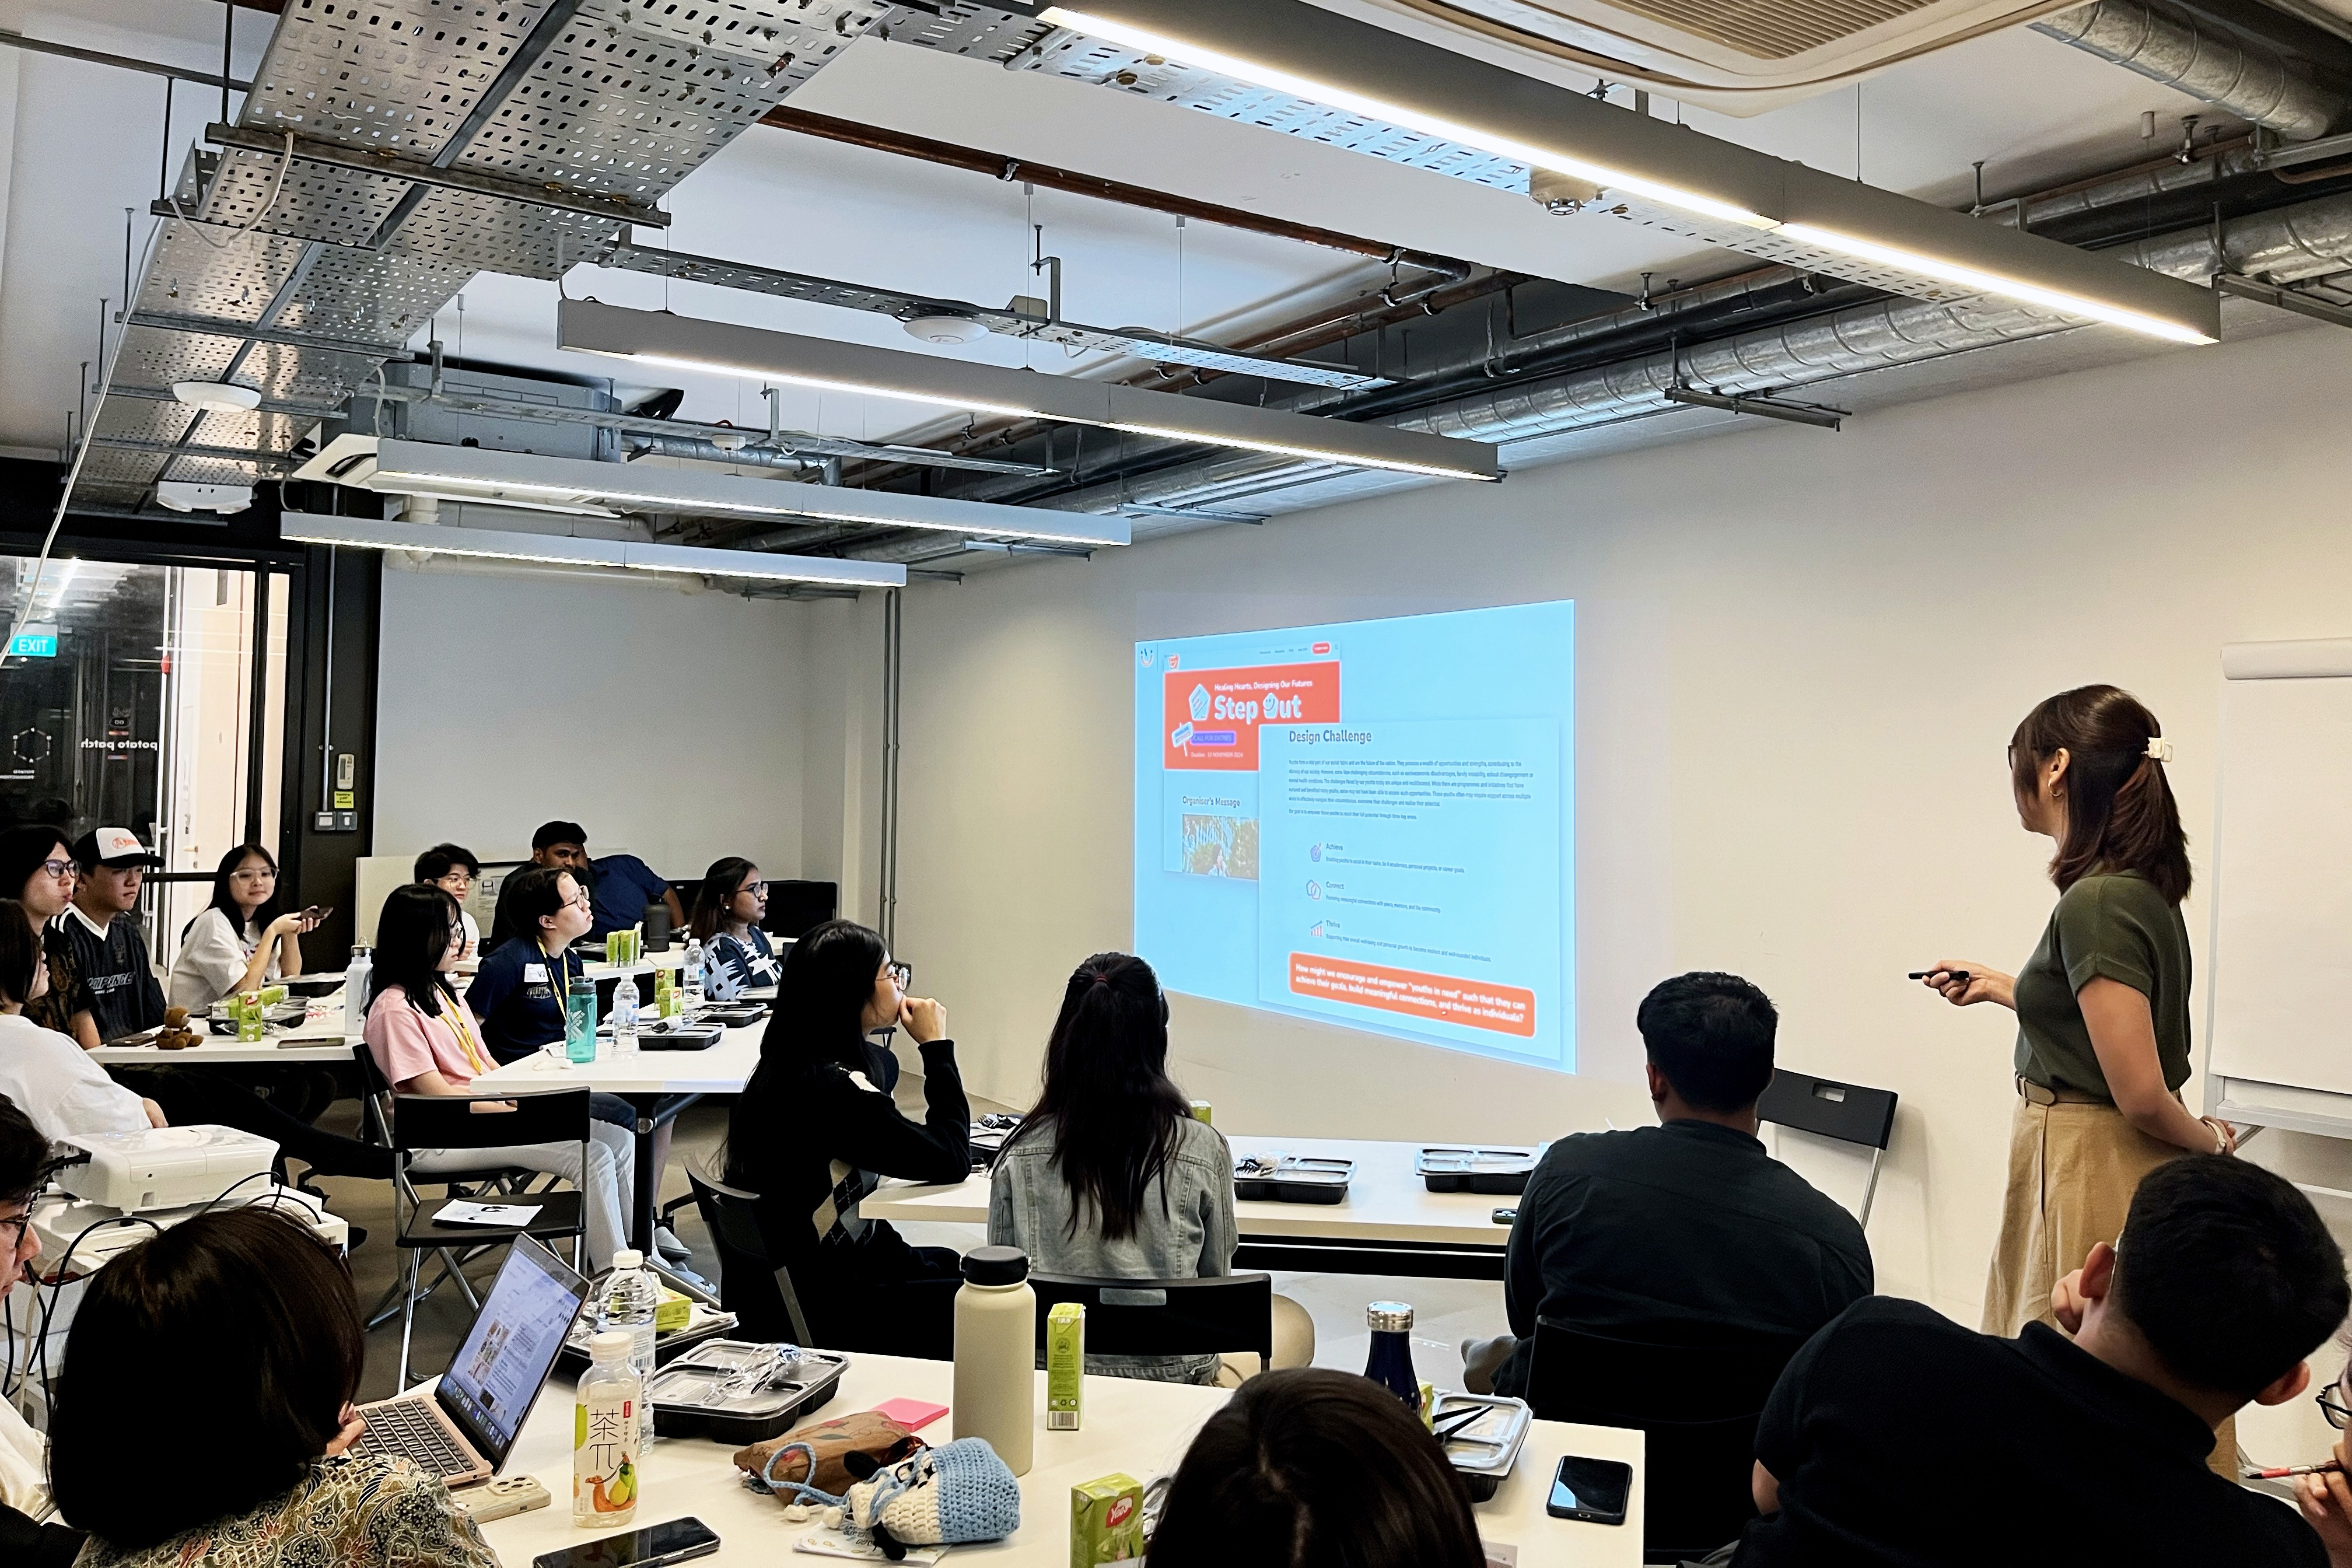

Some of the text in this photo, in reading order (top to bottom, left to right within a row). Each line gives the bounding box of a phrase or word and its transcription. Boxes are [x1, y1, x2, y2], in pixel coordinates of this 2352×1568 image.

[18, 639, 48, 653] EXIT
[1214, 679, 1312, 692] Healing Hearts, Designing Our Futures
[1214, 692, 1302, 724] Step Out
[1289, 730, 1371, 744] Design Challenge
[1182, 796, 1240, 808] Organiser's Message
[1296, 963, 1308, 973] How
[1310, 966, 1326, 977] might
[1336, 972, 1366, 984] encourage
[1366, 976, 1378, 985] and
[1379, 979, 1408, 989] empower
[1434, 987, 1440, 996] in
[1462, 992, 1478, 1002] such
[1479, 995, 1494, 1006] that
[1495, 996, 1511, 1009] they
[1513, 1002, 1525, 1010] can
[1296, 975, 1524, 1023] achieve their goals, build meaningful connections, and thrive as individuals?
